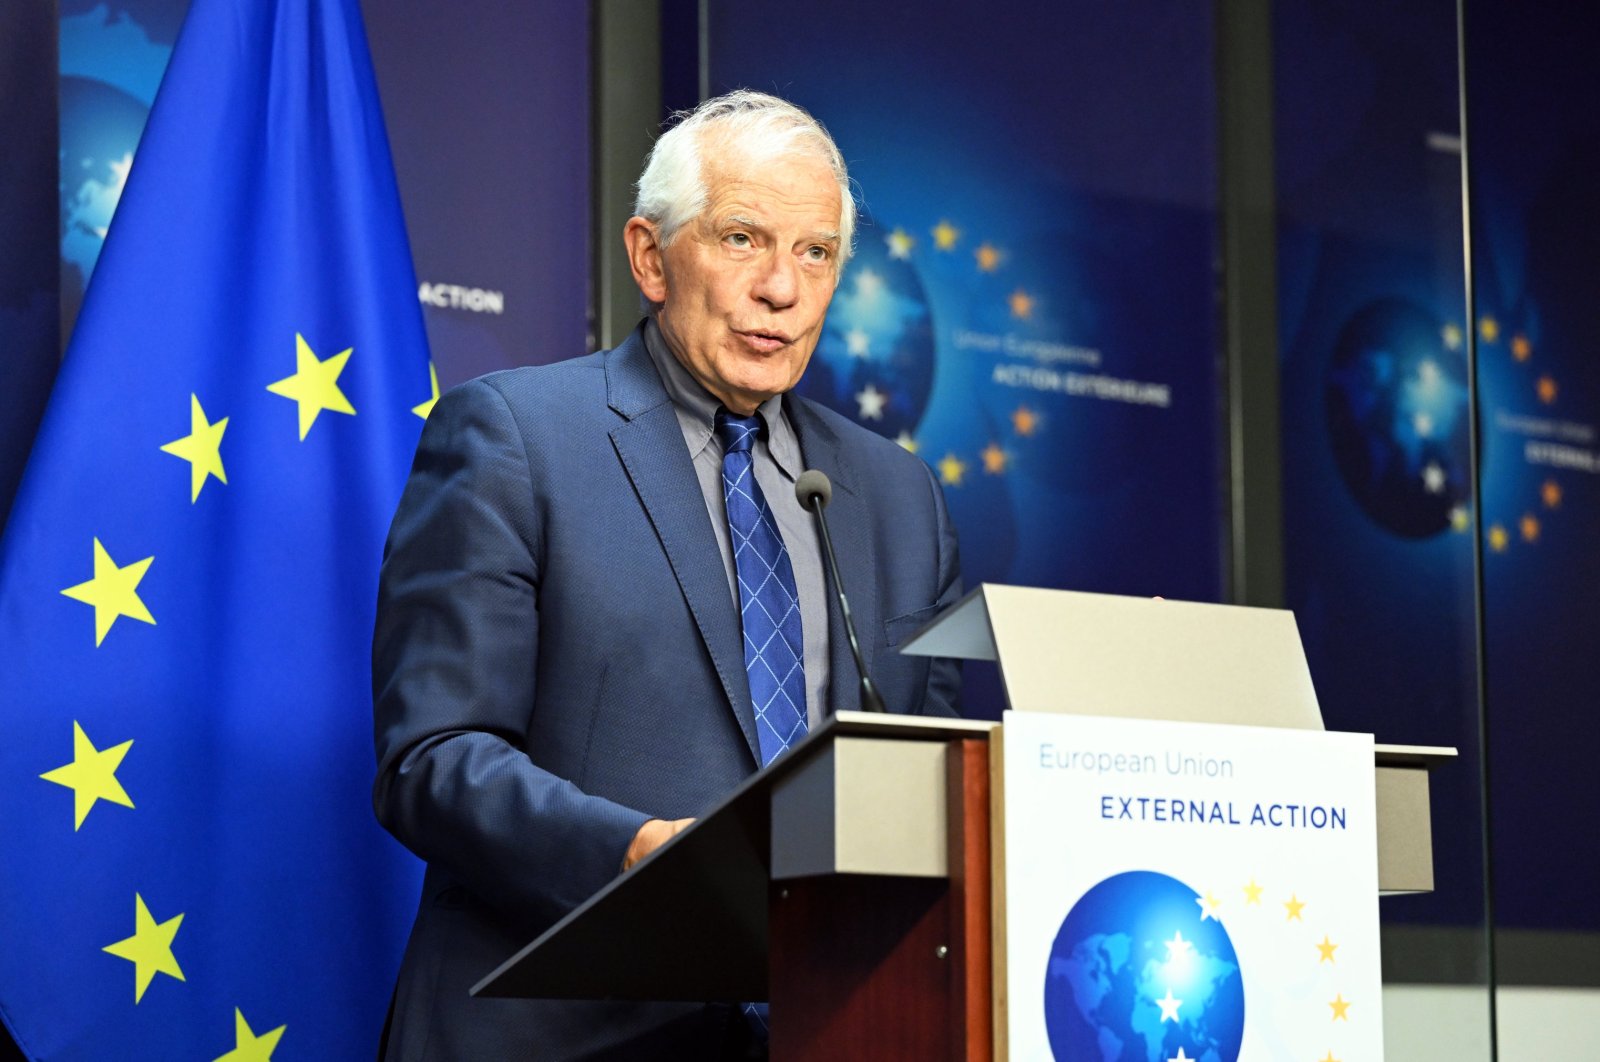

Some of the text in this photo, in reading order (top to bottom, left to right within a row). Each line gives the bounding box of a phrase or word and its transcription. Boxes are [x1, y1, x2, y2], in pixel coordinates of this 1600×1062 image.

[418, 282, 504, 314] ACTION
[993, 364, 1060, 391] ACTION
[1039, 743, 1234, 778] European Union
[1101, 796, 1346, 830] EXTERNAL ACTION
